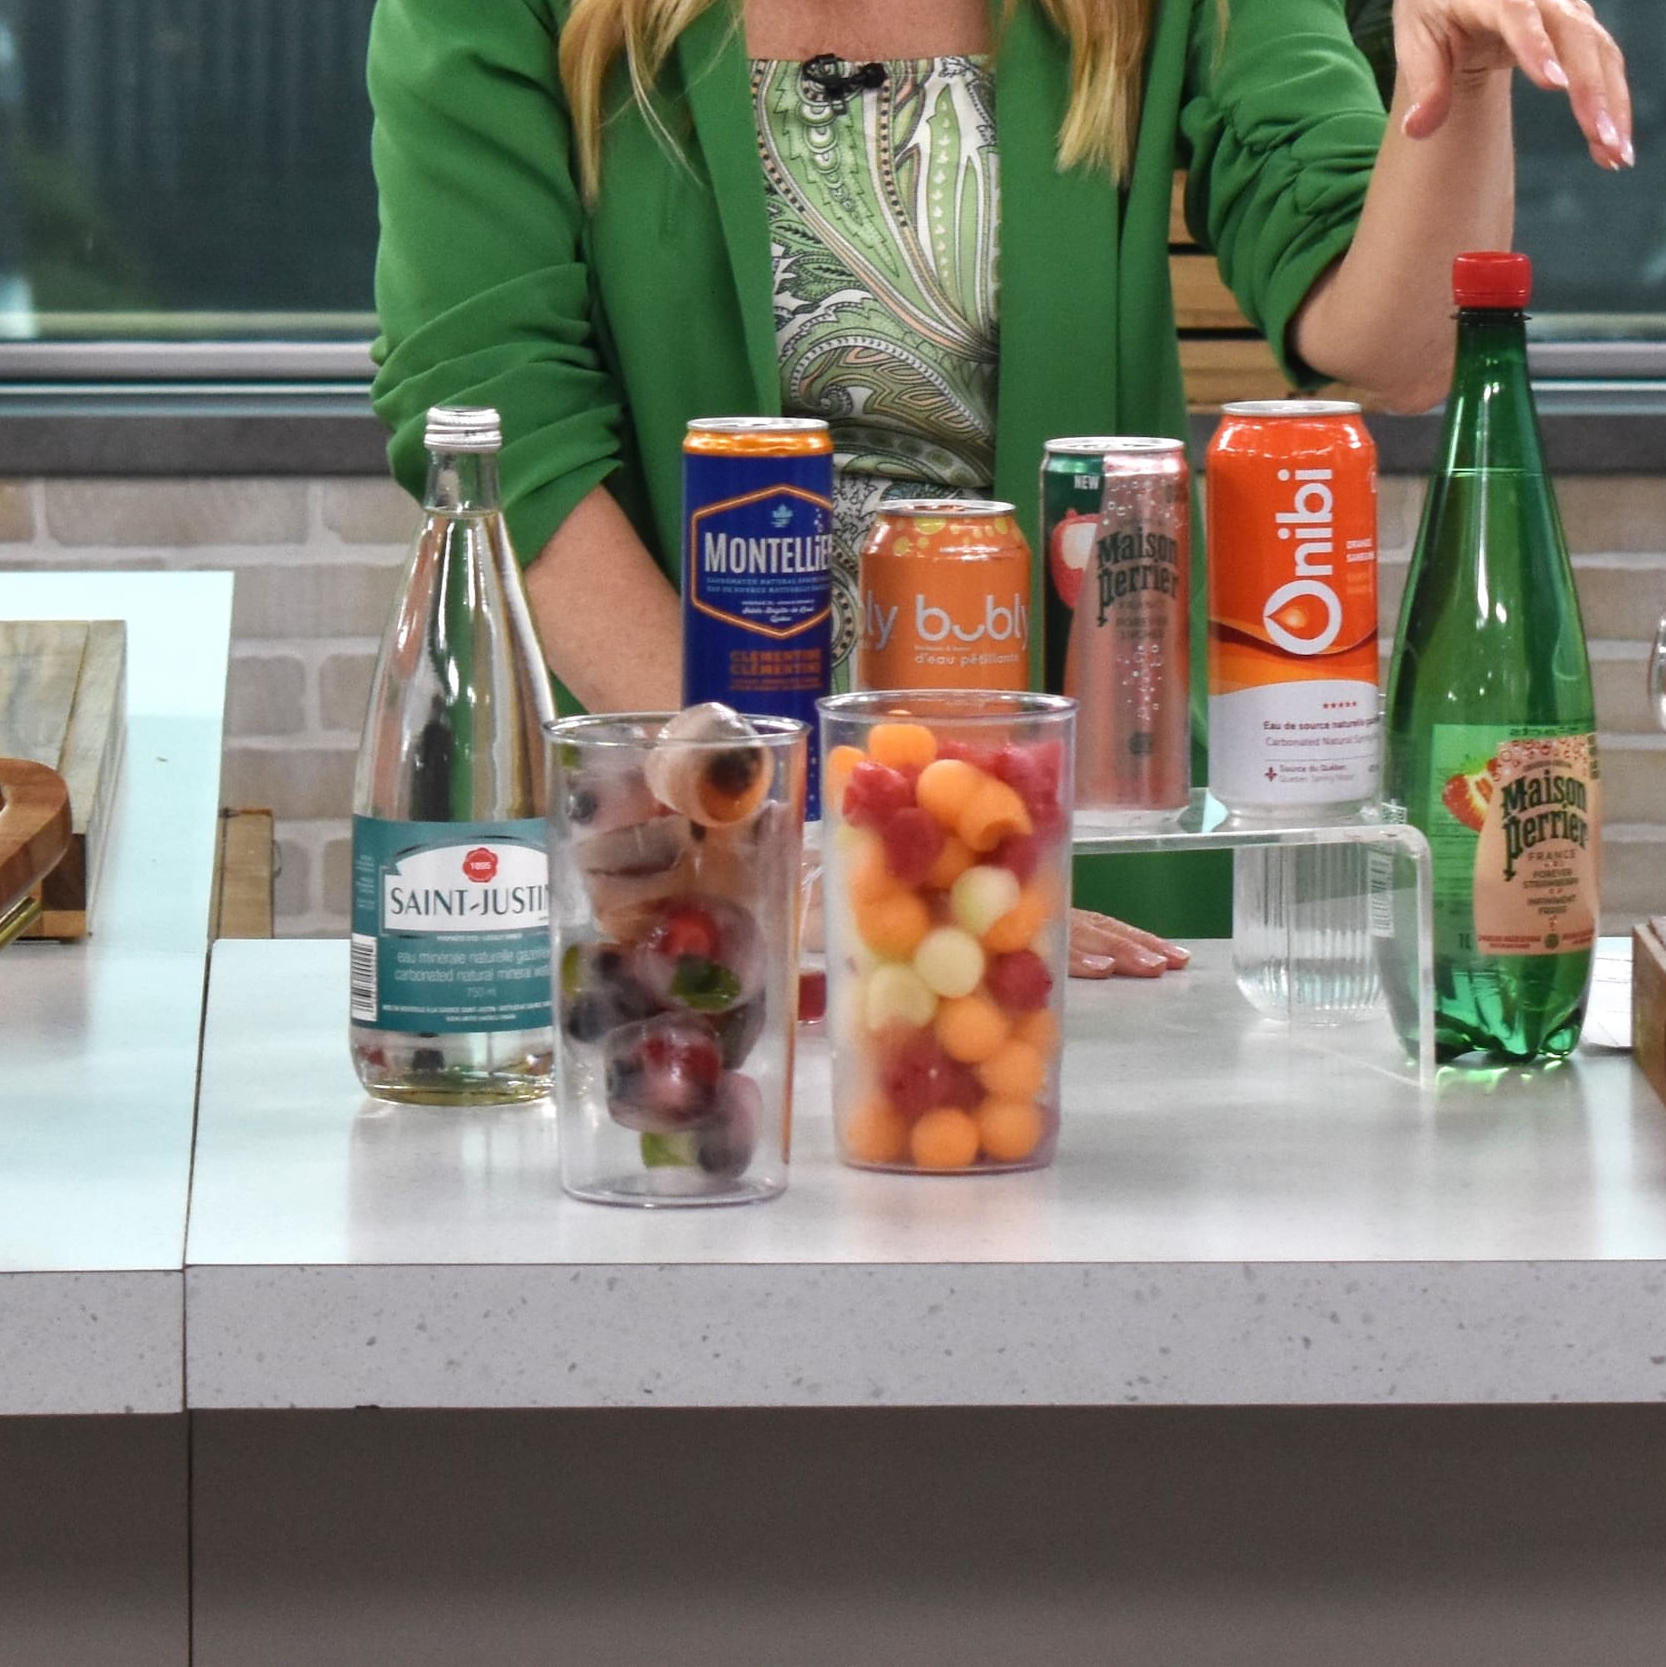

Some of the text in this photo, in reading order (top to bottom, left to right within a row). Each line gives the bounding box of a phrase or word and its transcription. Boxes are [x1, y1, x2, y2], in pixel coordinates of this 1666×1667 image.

[1074, 475, 1100, 489] NEW
[1098, 527, 1178, 565] Maison
[1263, 469, 1342, 655] Onibi
[916, 592, 1028, 651] bubly
[1501, 768, 1588, 815] Maison
[1501, 807, 1589, 882] Perrier
